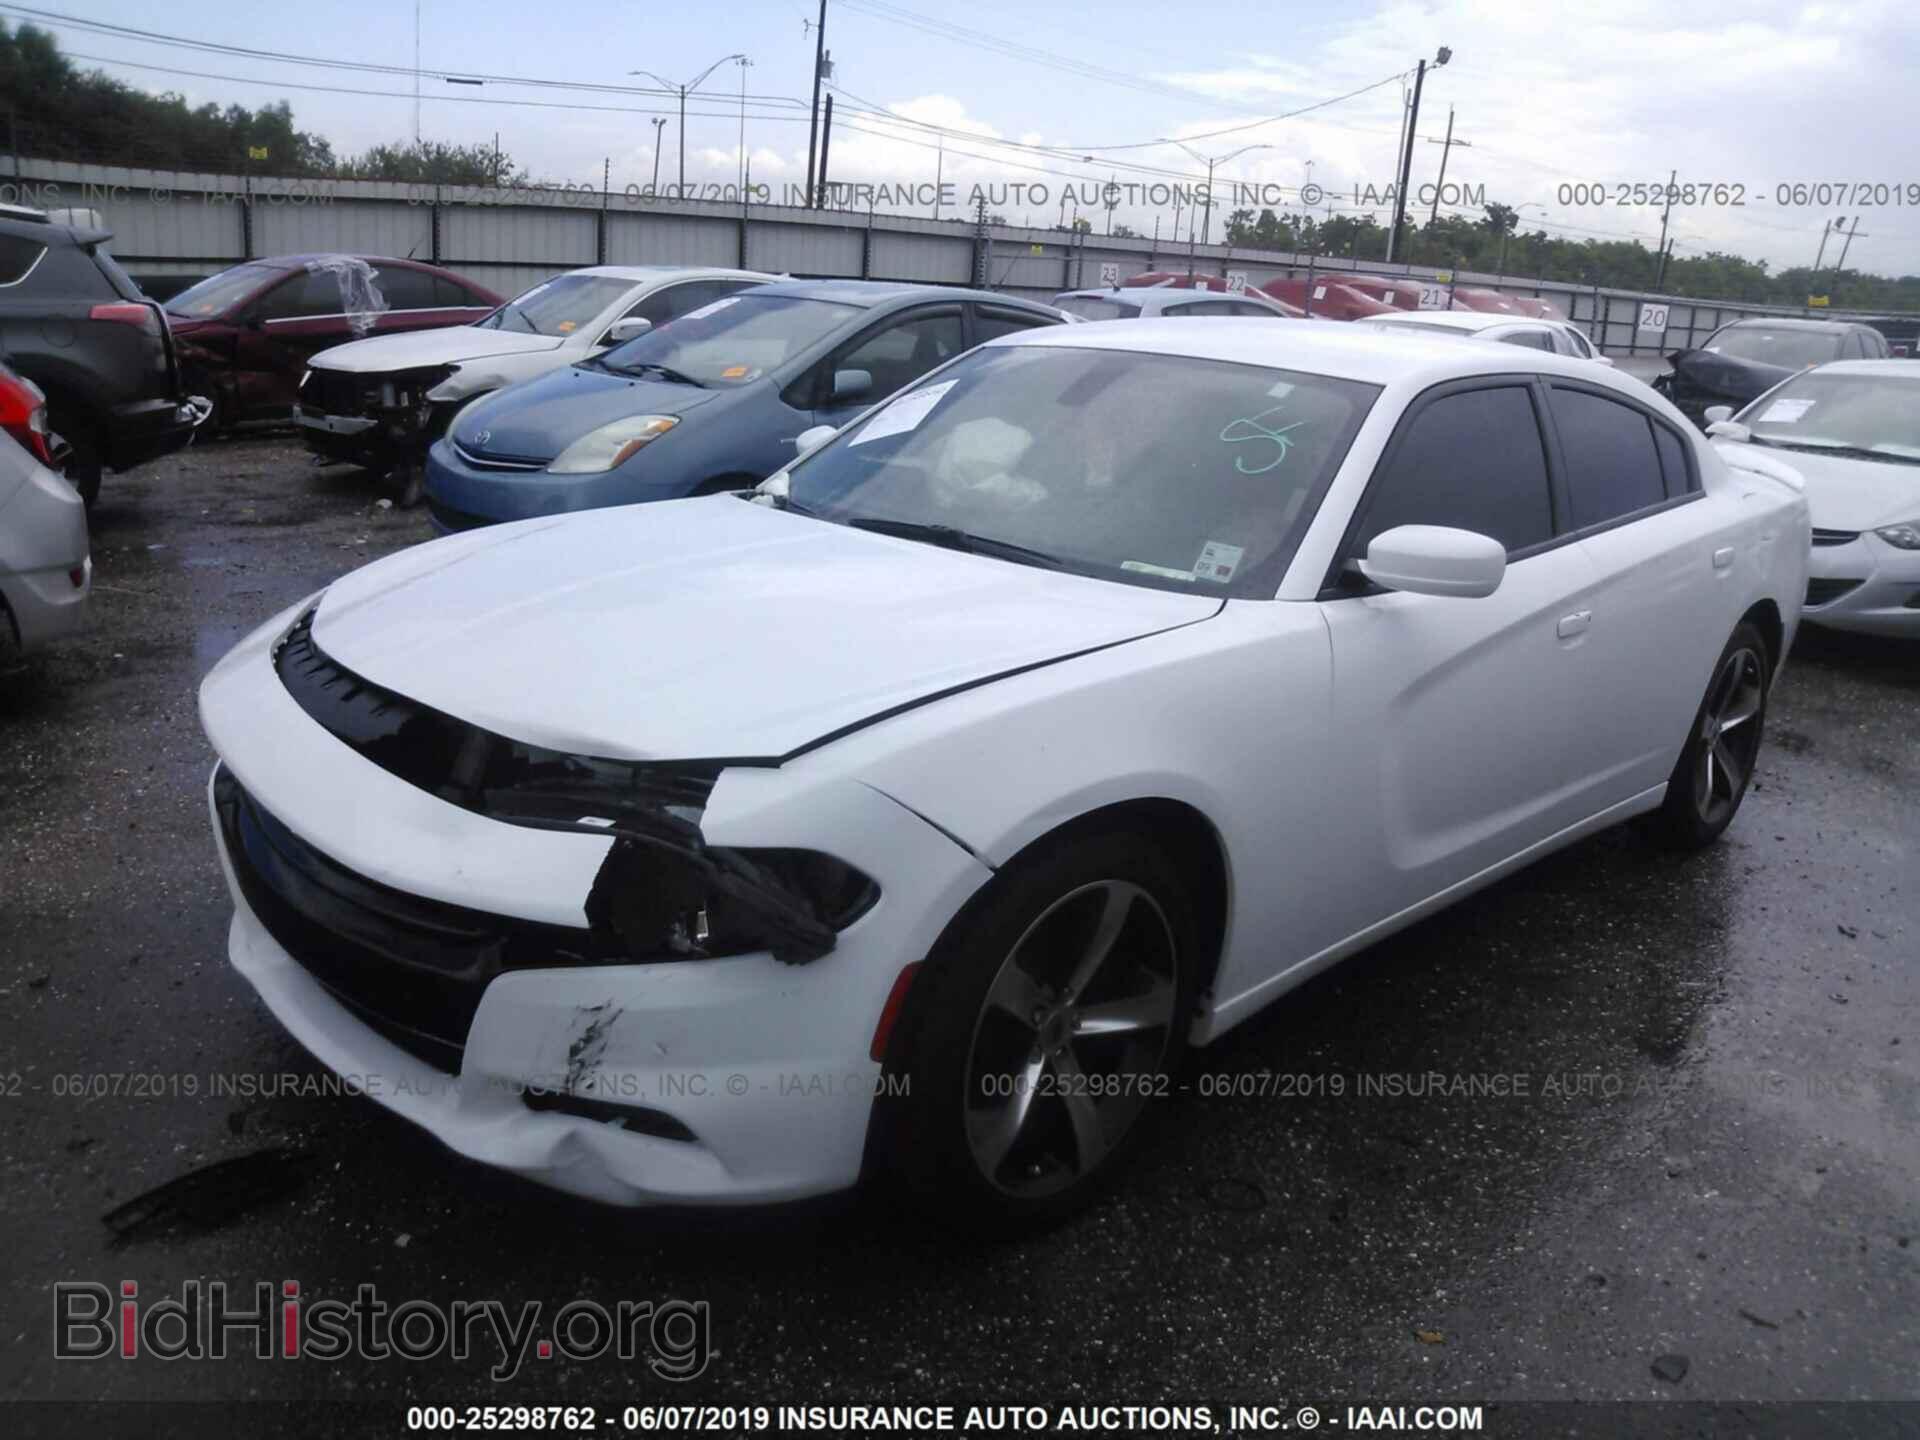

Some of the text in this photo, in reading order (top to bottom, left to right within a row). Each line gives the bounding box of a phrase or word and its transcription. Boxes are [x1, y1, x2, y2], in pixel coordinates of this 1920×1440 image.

[1228, 276, 1245, 291] 22
[1420, 289, 1440, 305] 21
[1641, 309, 1665, 327] 20
